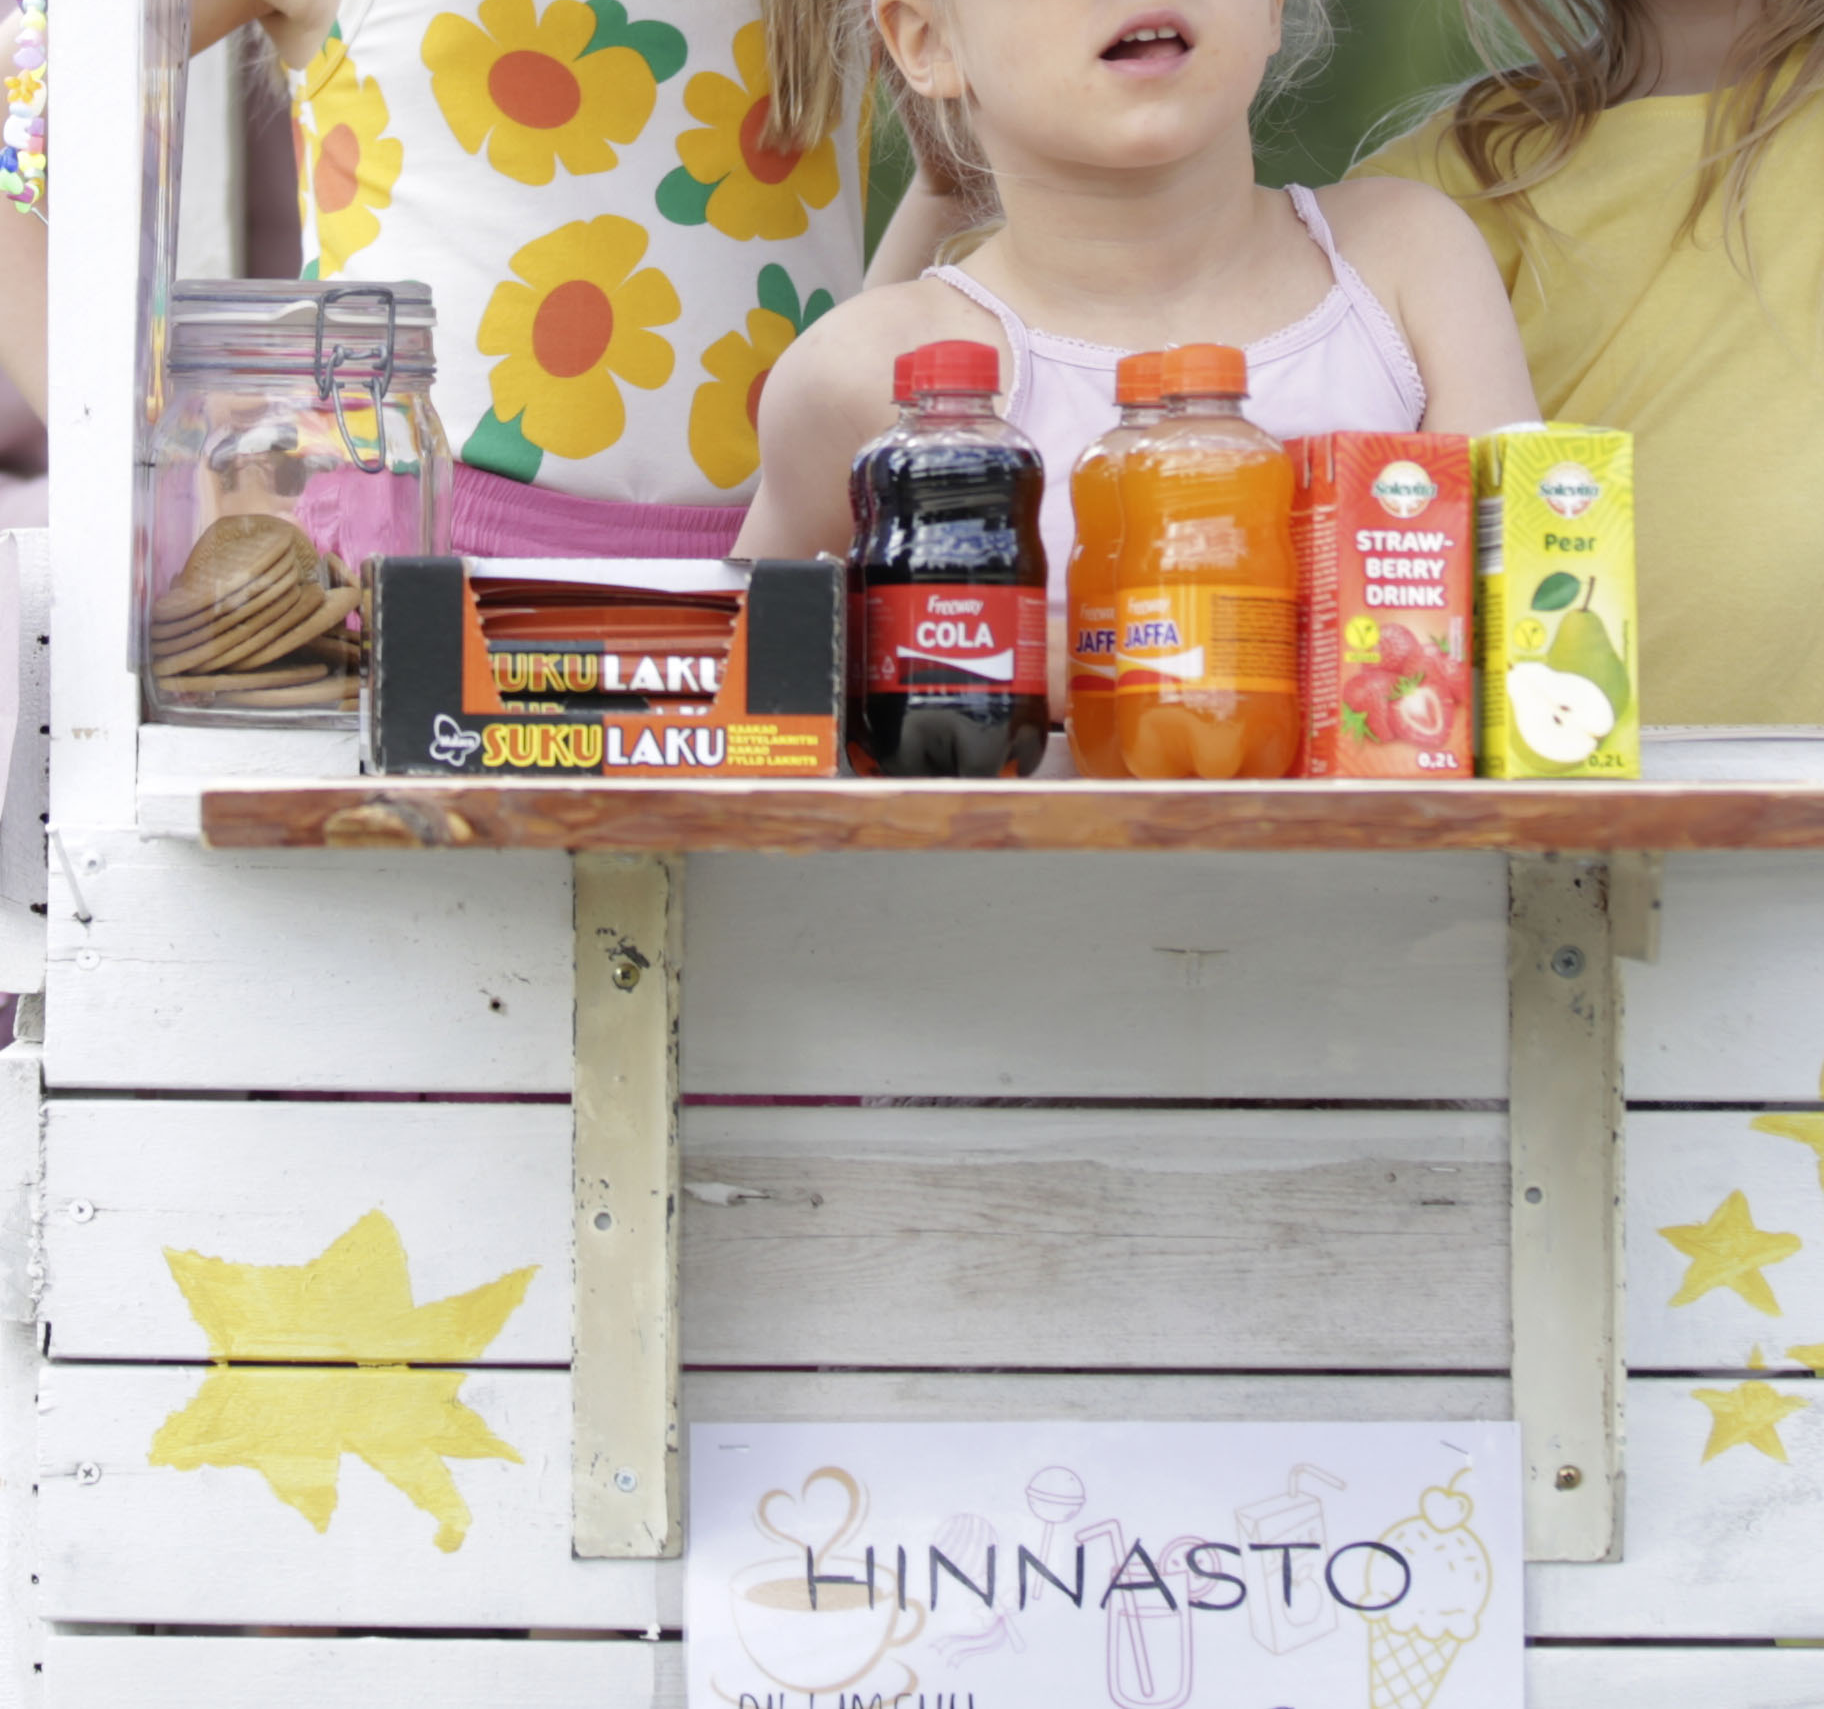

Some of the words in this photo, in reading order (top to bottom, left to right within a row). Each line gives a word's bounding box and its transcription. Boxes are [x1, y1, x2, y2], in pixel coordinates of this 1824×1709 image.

[1356, 529, 1455, 552] STRAW-
[1543, 533, 1596, 552] Pear
[1365, 556, 1446, 579] BERRY
[928, 594, 985, 616] Freeway
[1365, 583, 1445, 607] DRINK
[916, 620, 995, 648] COLA
[1076, 629, 1117, 653] JAFF
[1124, 621, 1179, 647] JAFFA
[490, 651, 723, 693] UKULAKU
[482, 723, 725, 768] SUKULAKU
[806, 1537, 1412, 1611] HINNASTO
